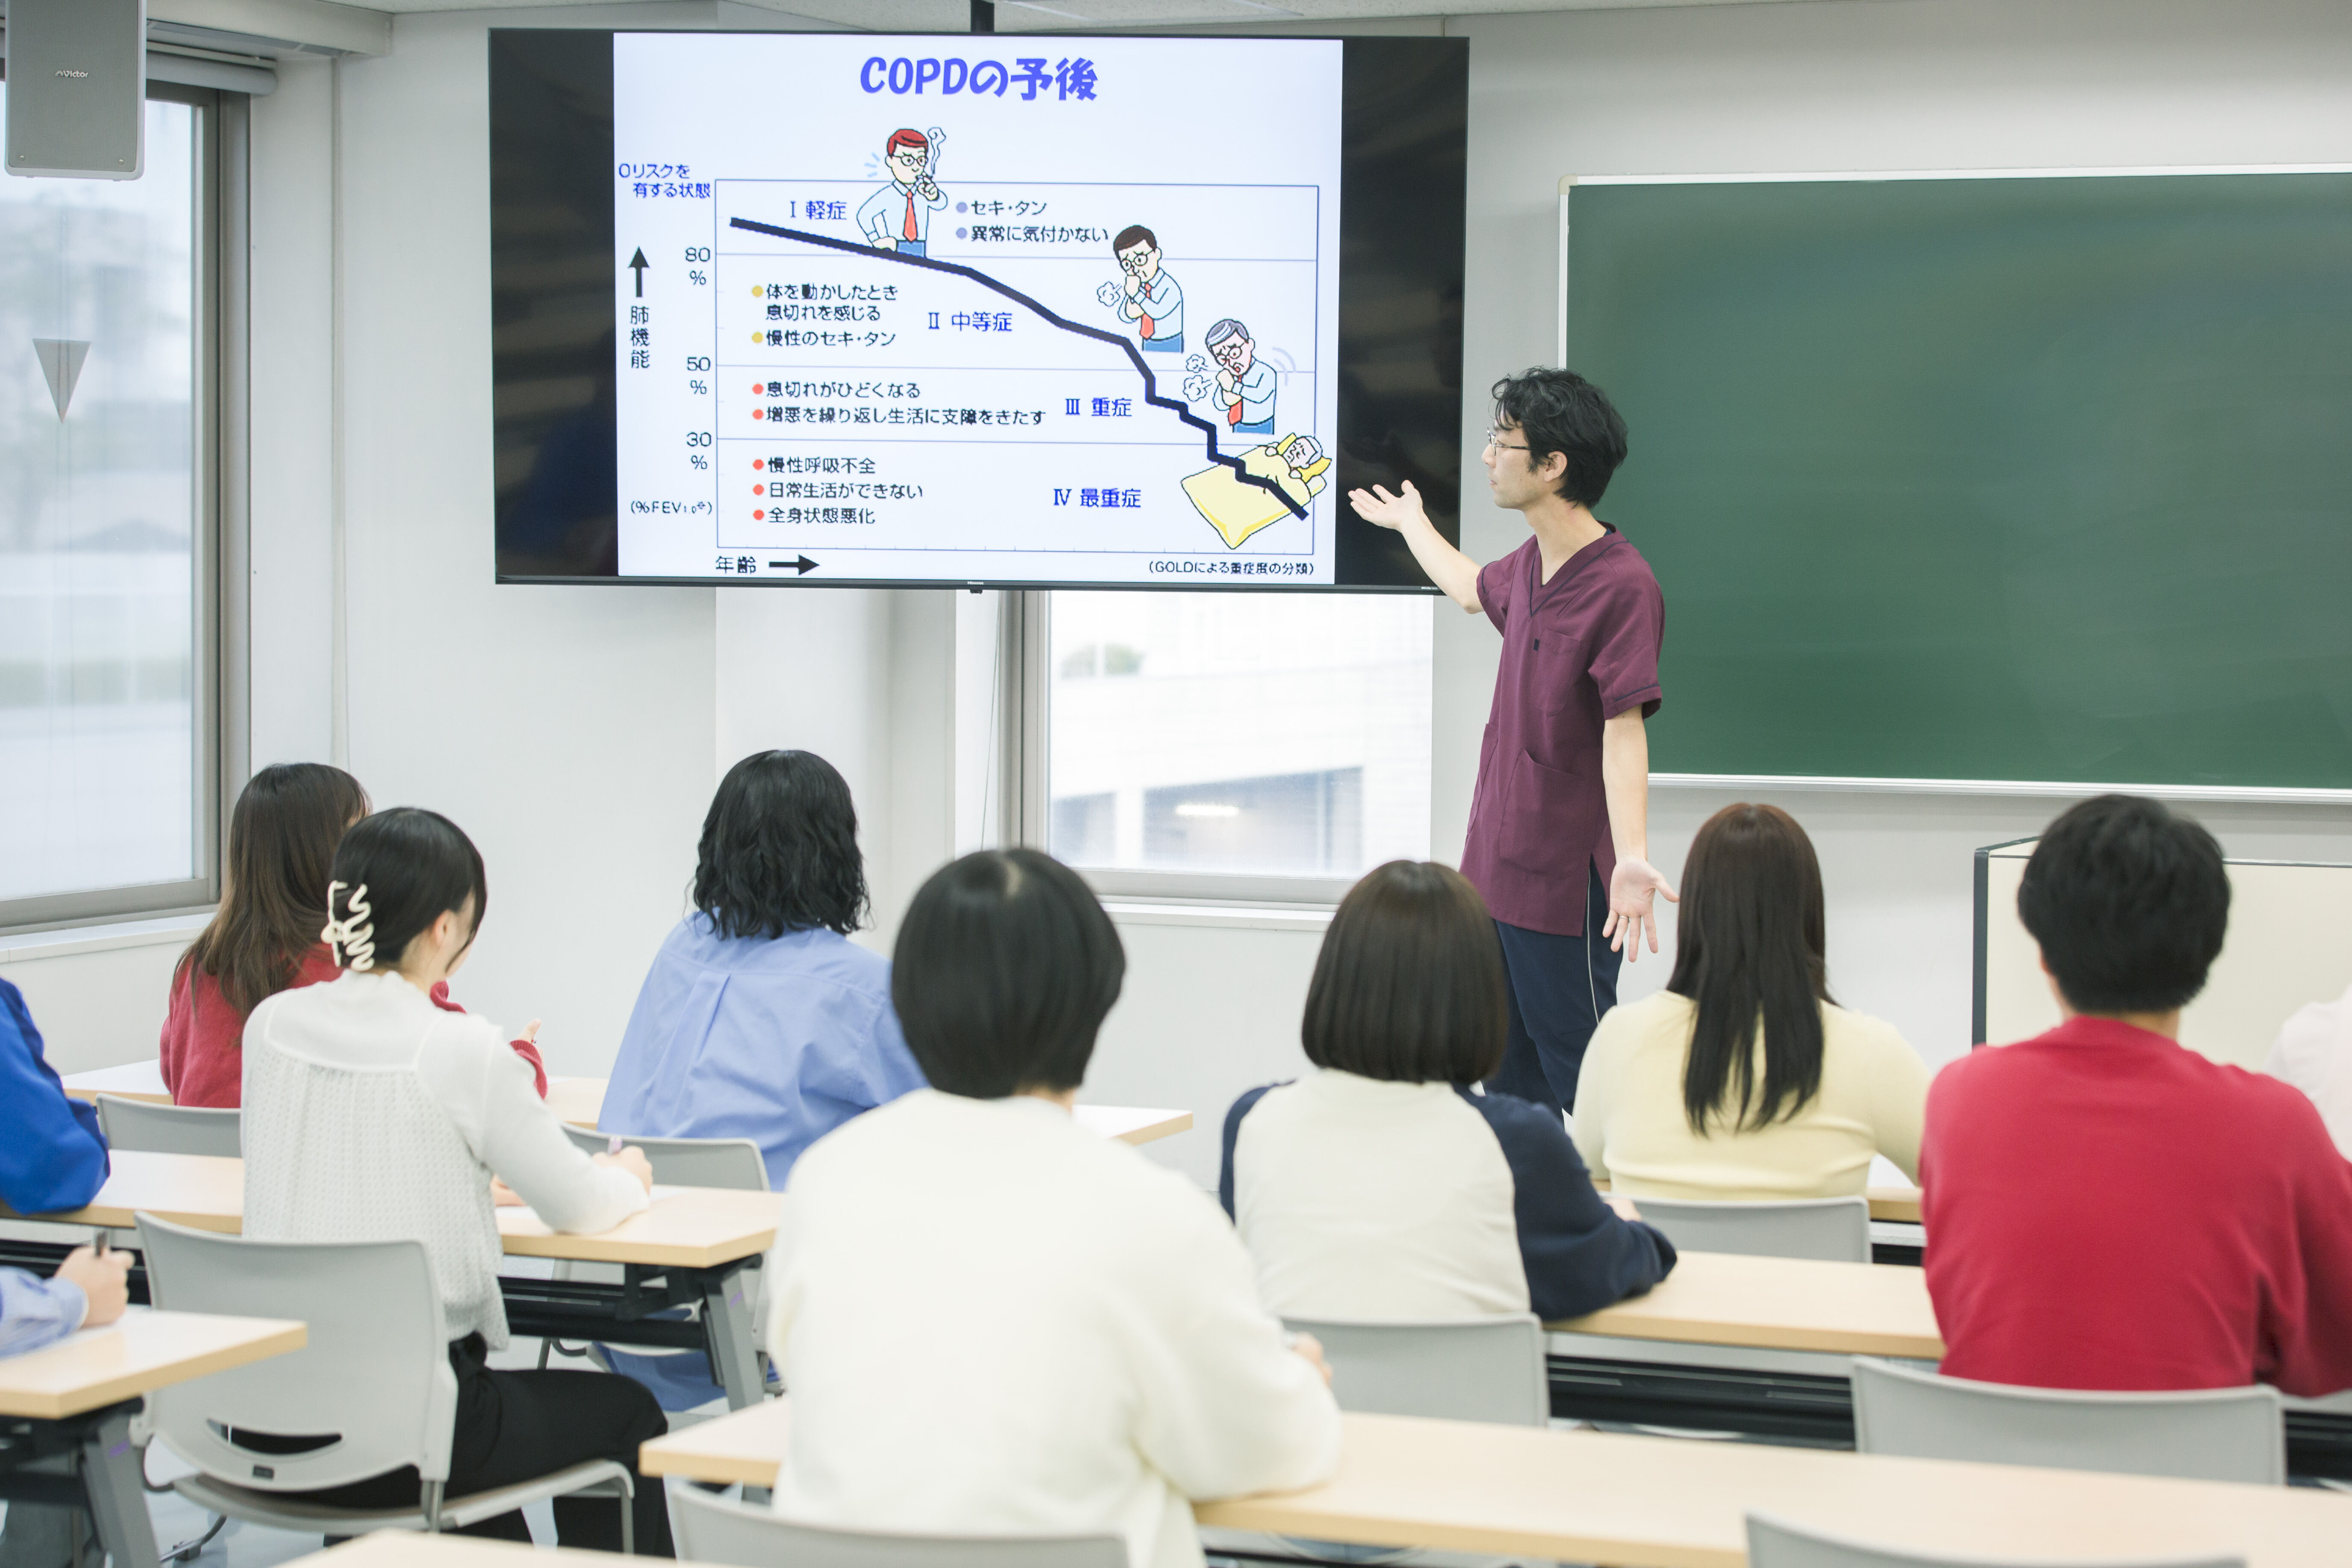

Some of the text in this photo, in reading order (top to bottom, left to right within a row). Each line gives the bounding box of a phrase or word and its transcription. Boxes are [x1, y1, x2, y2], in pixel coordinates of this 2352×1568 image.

[860, 56, 1098, 101] COPDの予後
[632, 182, 710, 199] 有する状態
[806, 200, 847, 220] 軽症
[971, 200, 1047, 216] セキ・タン
[971, 224, 1109, 243] 異常に気付かない
[685, 246, 711, 262] 80
[689, 270, 706, 285] %
[766, 282, 898, 301] 体を動かしたとき
[765, 305, 881, 322] 息切れを感じる
[951, 311, 1013, 332] 中等症
[629, 305, 650, 369] 肺機能
[686, 356, 711, 371] 50
[689, 380, 707, 395] %
[766, 381, 921, 399] 息切れがひどくなる
[766, 406, 1046, 425] 増悪を繰り返し生活に支障をきたす
[1091, 397, 1132, 417] 重症
[686, 431, 712, 447] 30
[690, 455, 708, 470] %
[768, 456, 876, 474] 慢性呼吸不全
[770, 481, 923, 499] 日常生活ができない
[1079, 487, 1141, 508] 最重症
[768, 507, 875, 524] 全身状態悪化
[715, 556, 756, 574] 年齢
